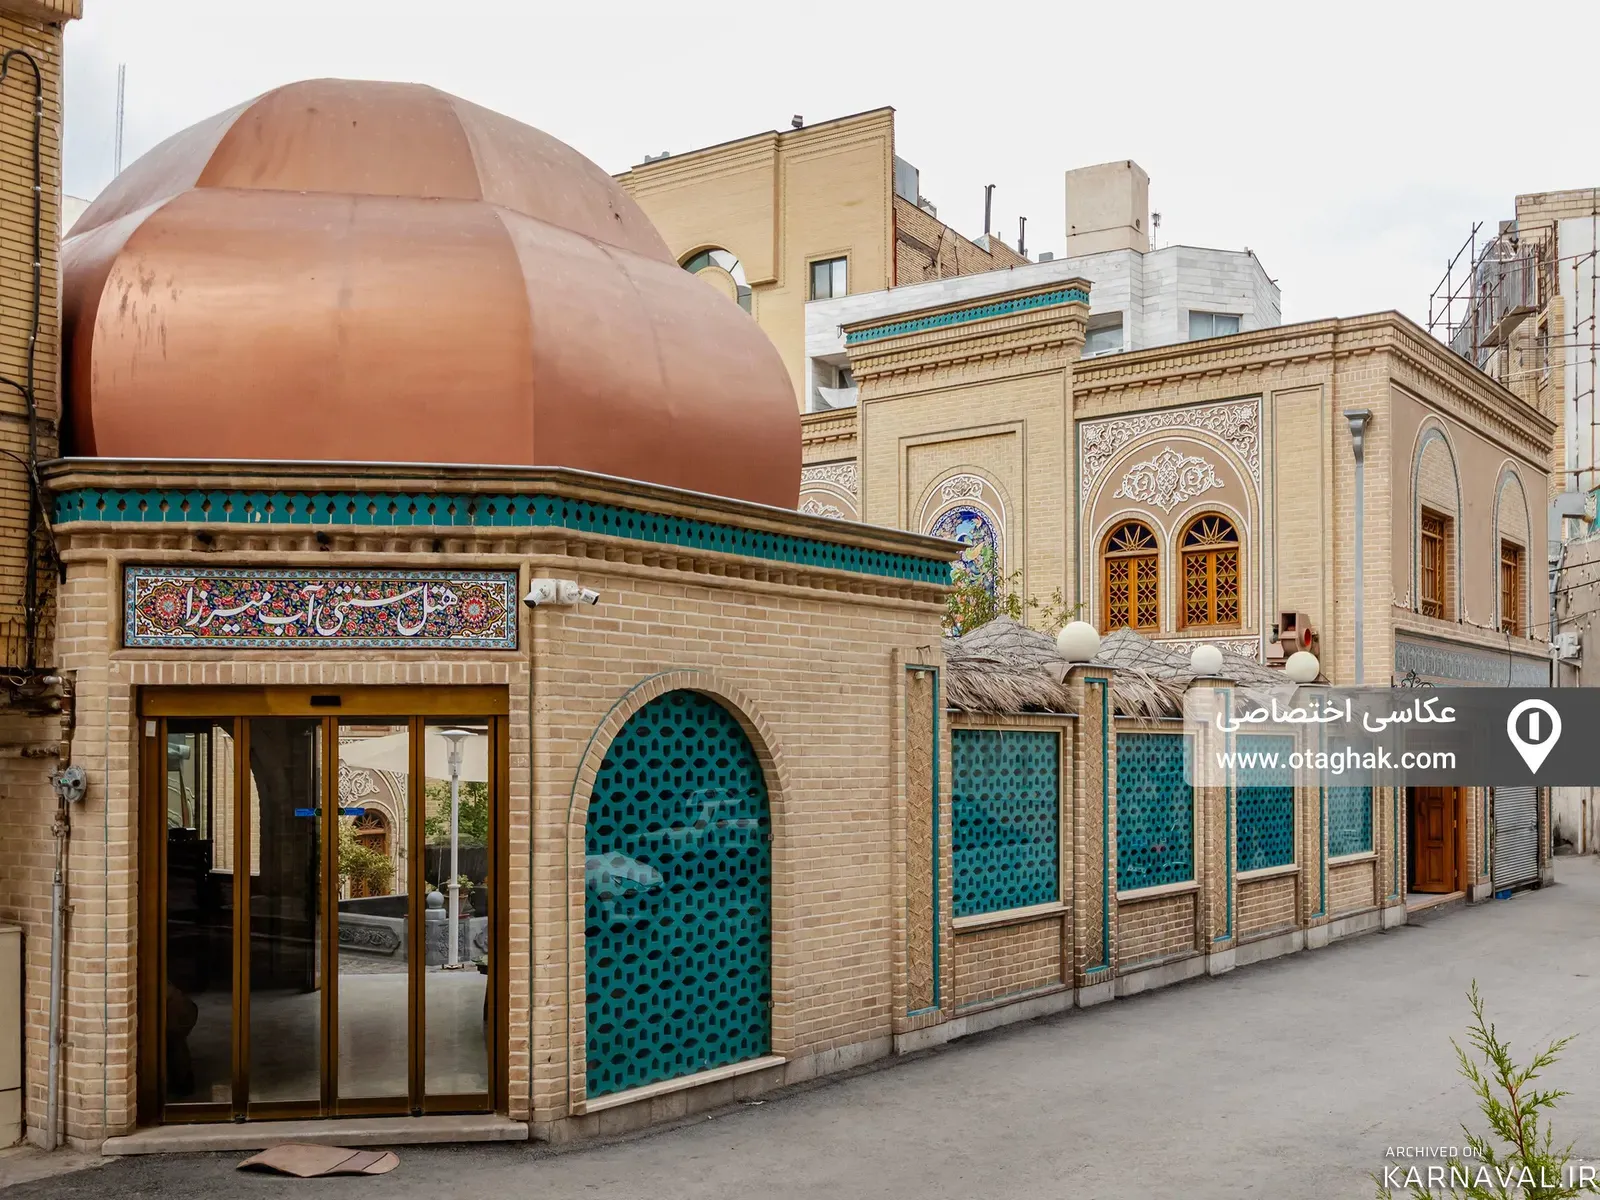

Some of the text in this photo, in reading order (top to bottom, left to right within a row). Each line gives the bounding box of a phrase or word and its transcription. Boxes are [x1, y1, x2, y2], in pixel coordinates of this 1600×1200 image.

[185, 582, 458, 636] هتل سنتی آب میرزا
